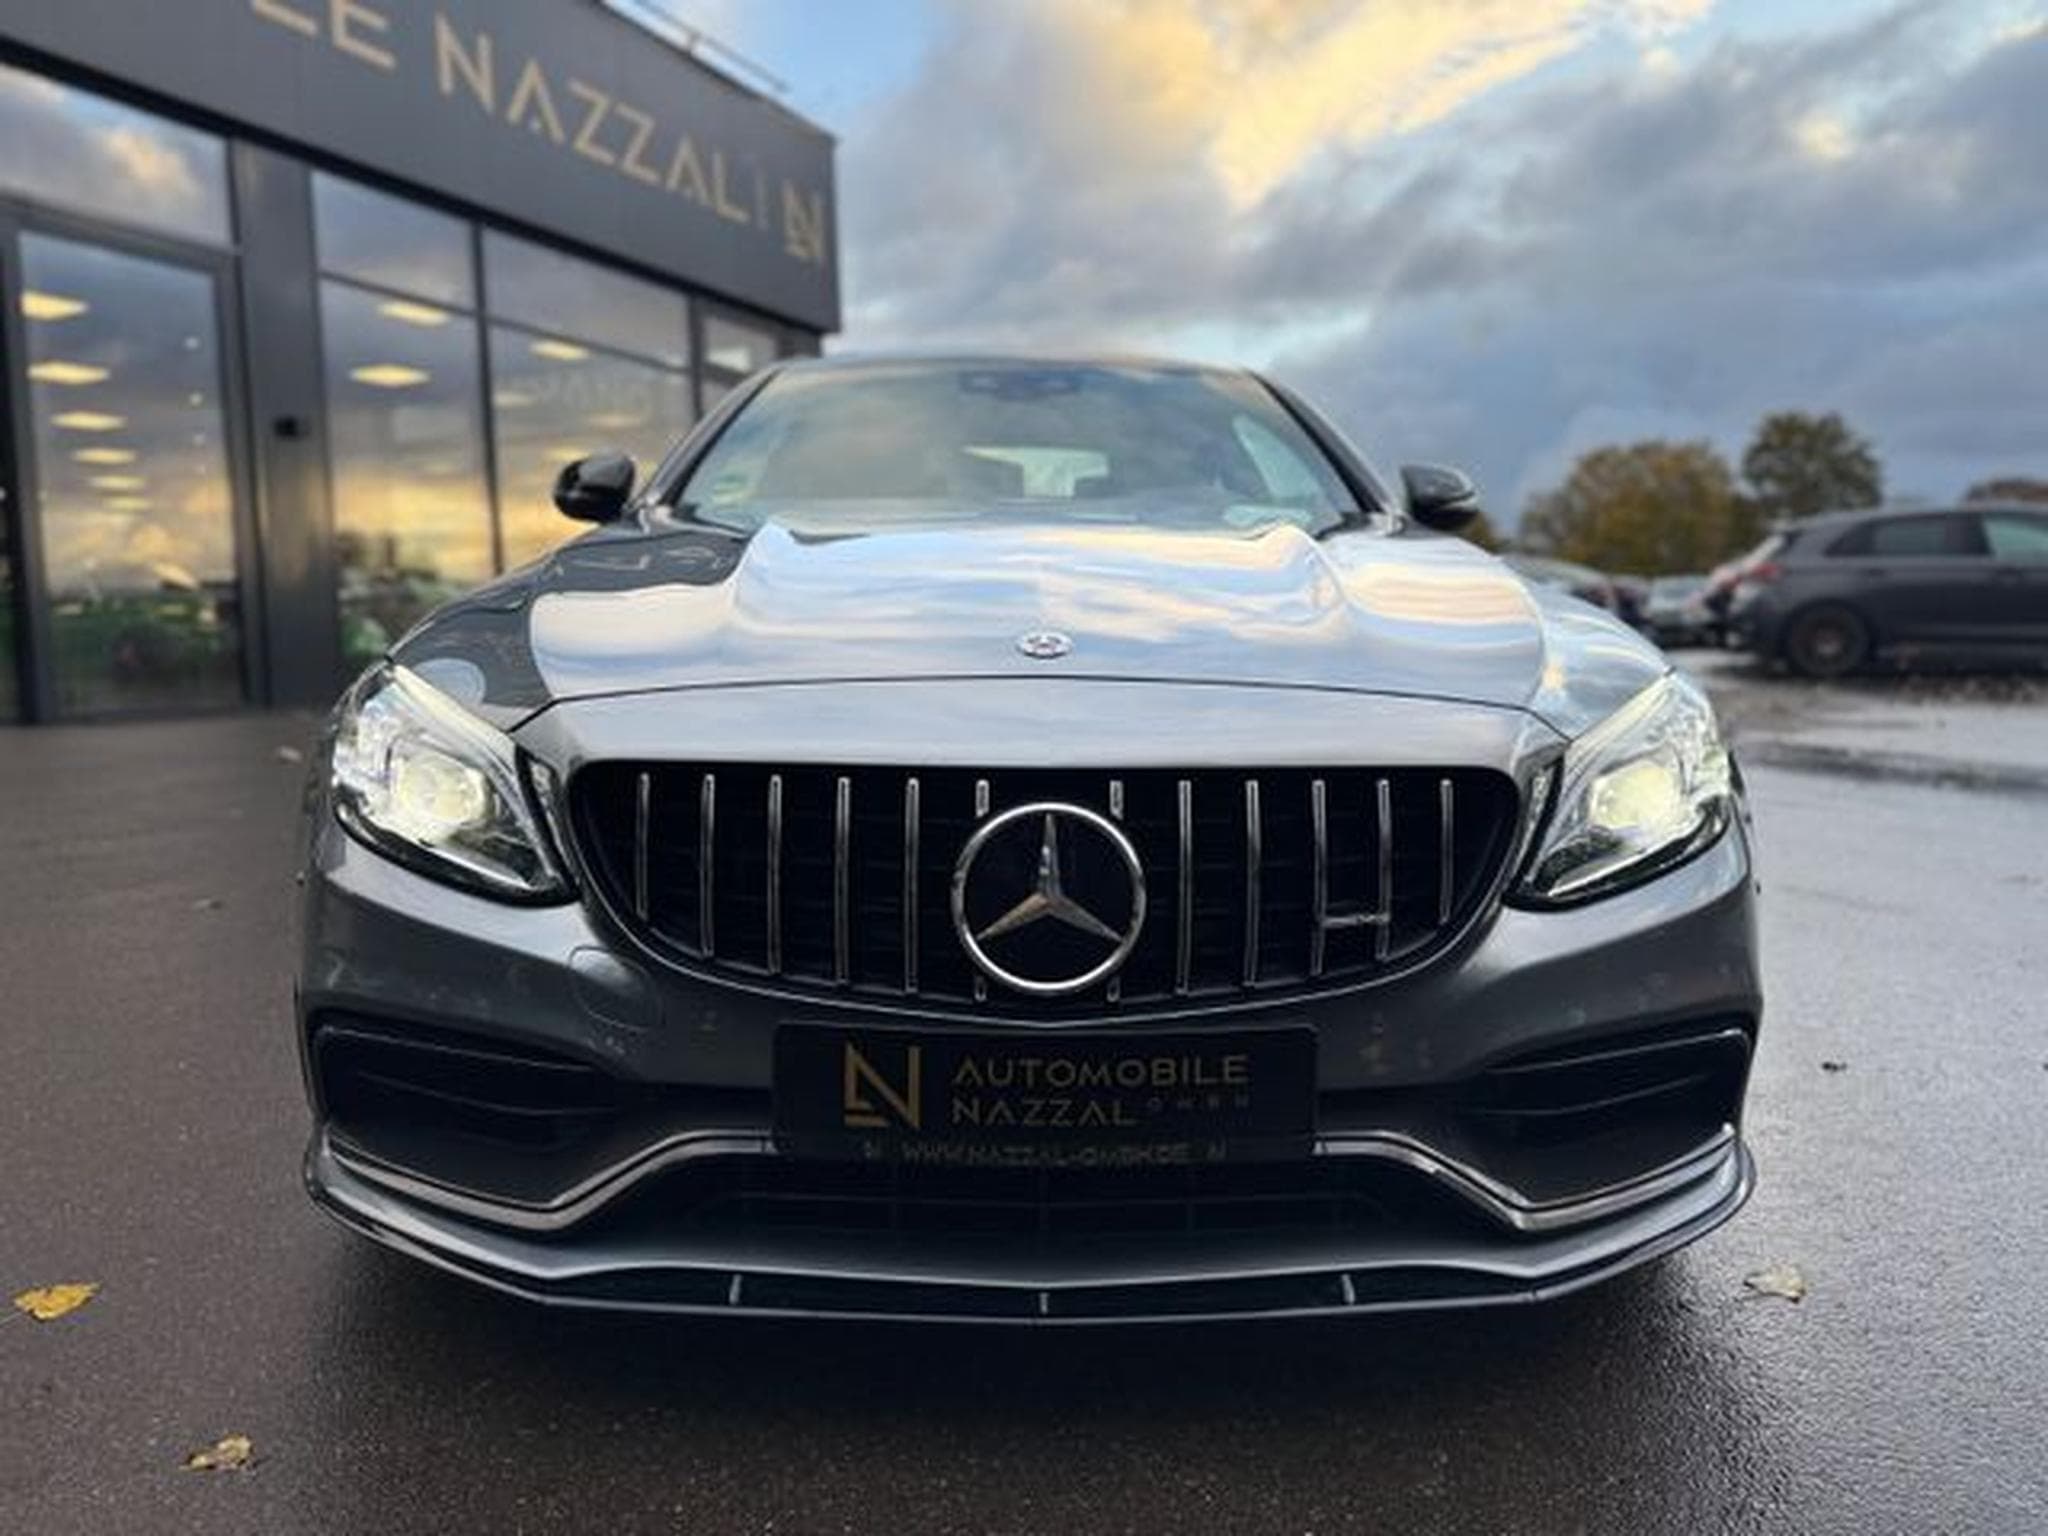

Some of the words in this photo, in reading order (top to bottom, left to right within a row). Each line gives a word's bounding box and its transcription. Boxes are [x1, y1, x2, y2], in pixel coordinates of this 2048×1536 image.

[432, 9, 752, 224] NAZZAL
[952, 1052, 1250, 1088] AUTOMOBILE
[951, 1097, 1138, 1128] NAZZAL
